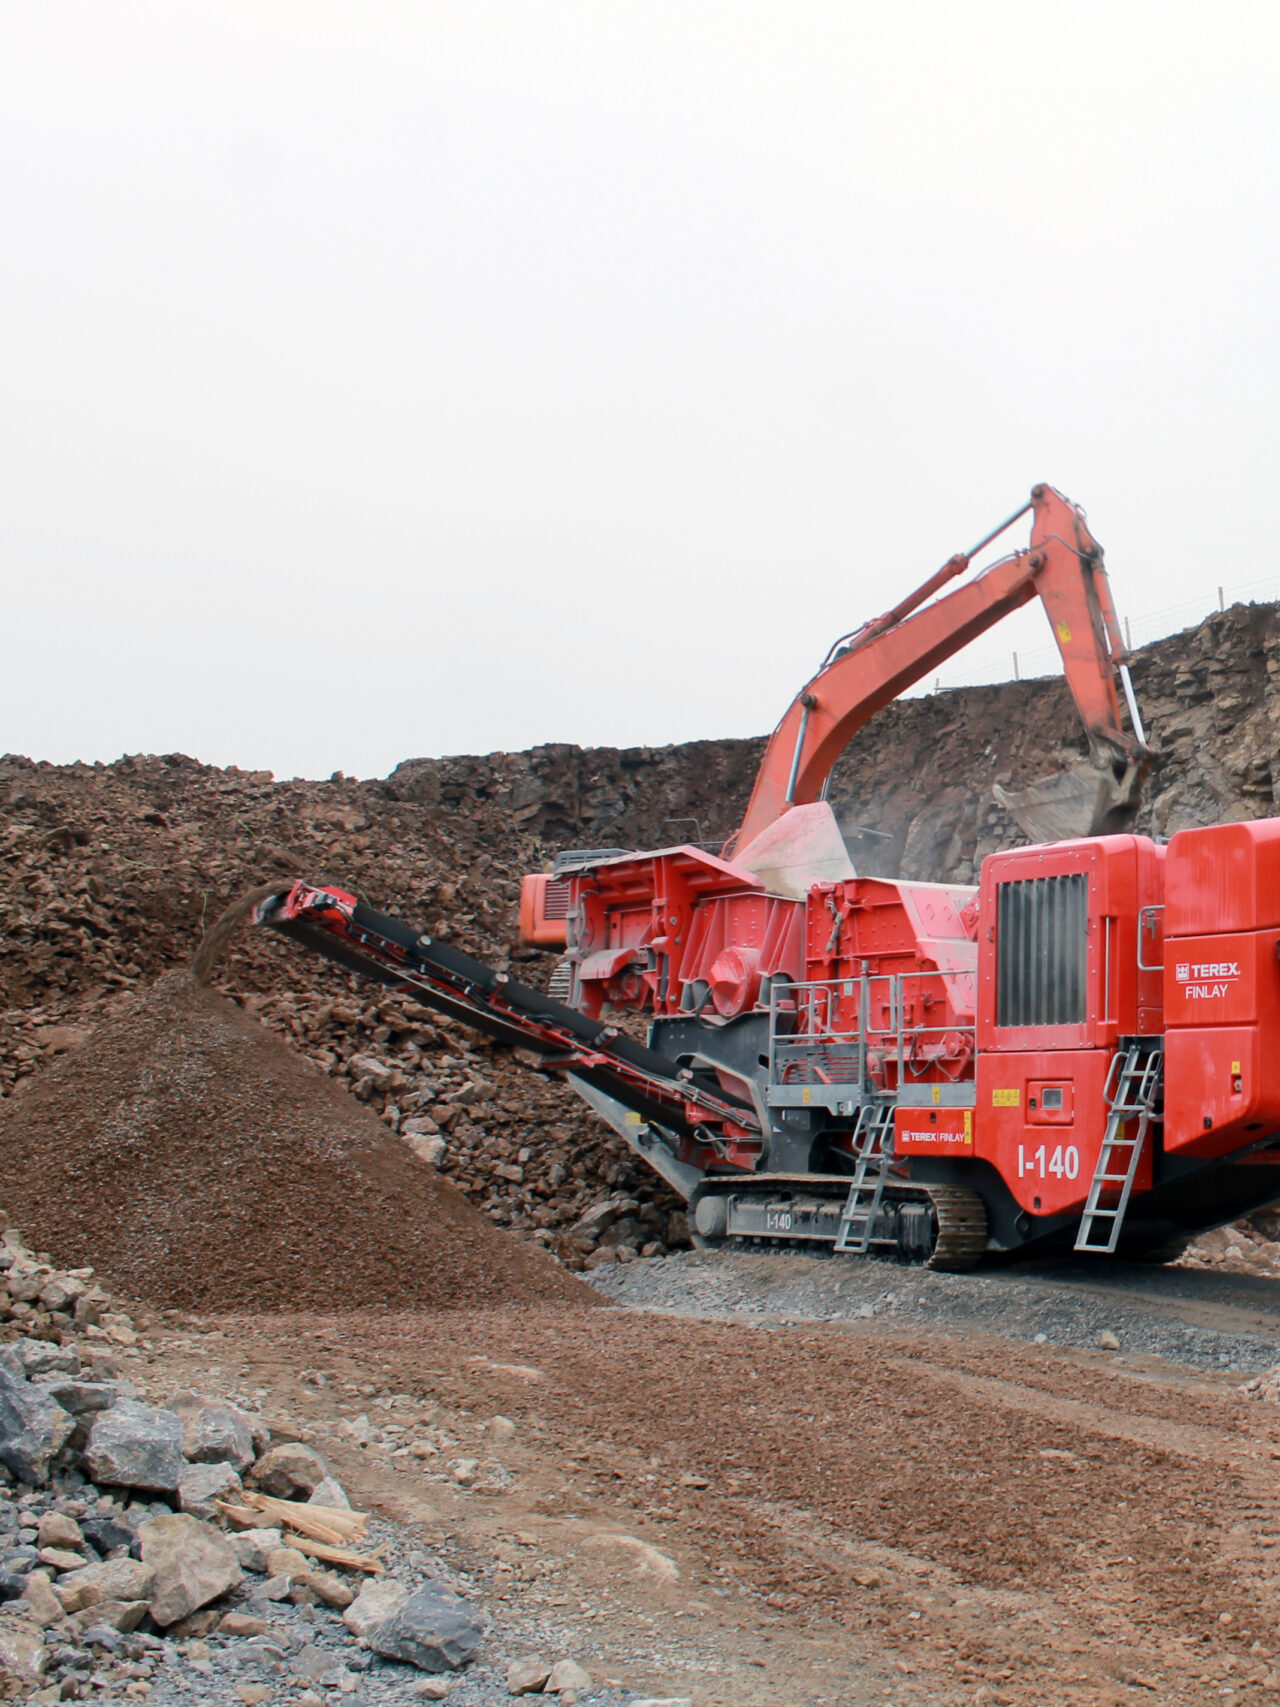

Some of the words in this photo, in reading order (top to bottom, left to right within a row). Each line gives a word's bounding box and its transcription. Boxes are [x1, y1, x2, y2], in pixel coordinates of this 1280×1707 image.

[1185, 984, 1229, 999] FINLAY
[910, 1132, 937, 1142] TEREX
[939, 1133, 965, 1142] FINLAY
[1018, 1144, 1080, 1180] I-140
[767, 1212, 792, 1230] I-140
